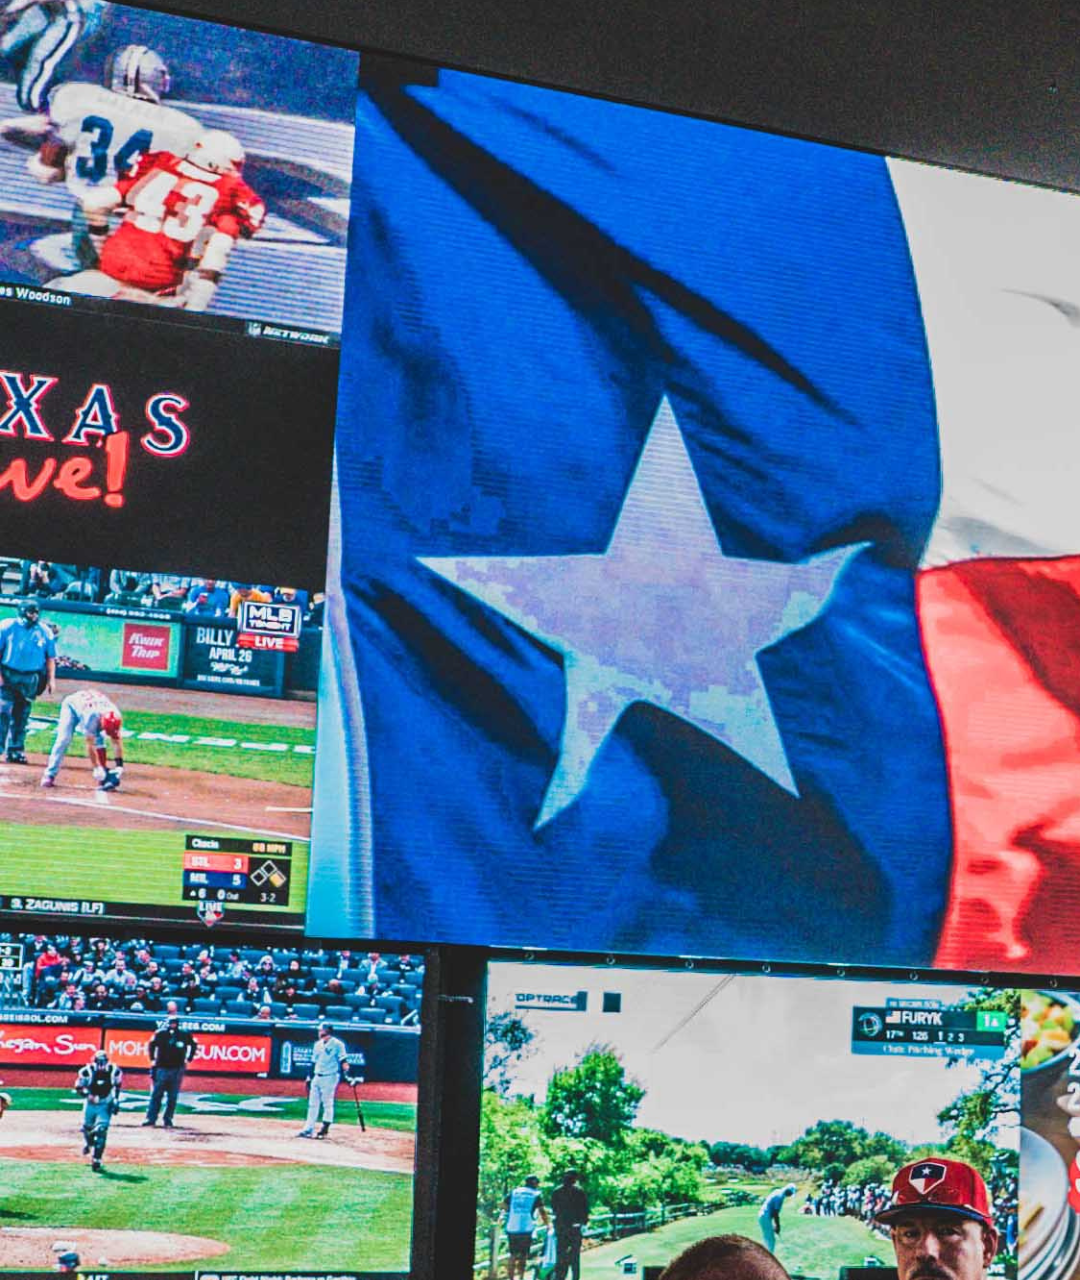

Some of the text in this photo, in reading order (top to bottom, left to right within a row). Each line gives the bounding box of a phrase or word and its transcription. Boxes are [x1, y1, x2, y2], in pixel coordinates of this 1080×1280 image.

[15, 286, 71, 306] Woodson
[248, 605, 293, 622] MLB
[195, 626, 234, 646] BILLY
[254, 635, 285, 649] LIVE
[208, 647, 238, 662] APRIL
[901, 1010, 943, 1026] FURYK
[958, 1033, 965, 1043] 3
